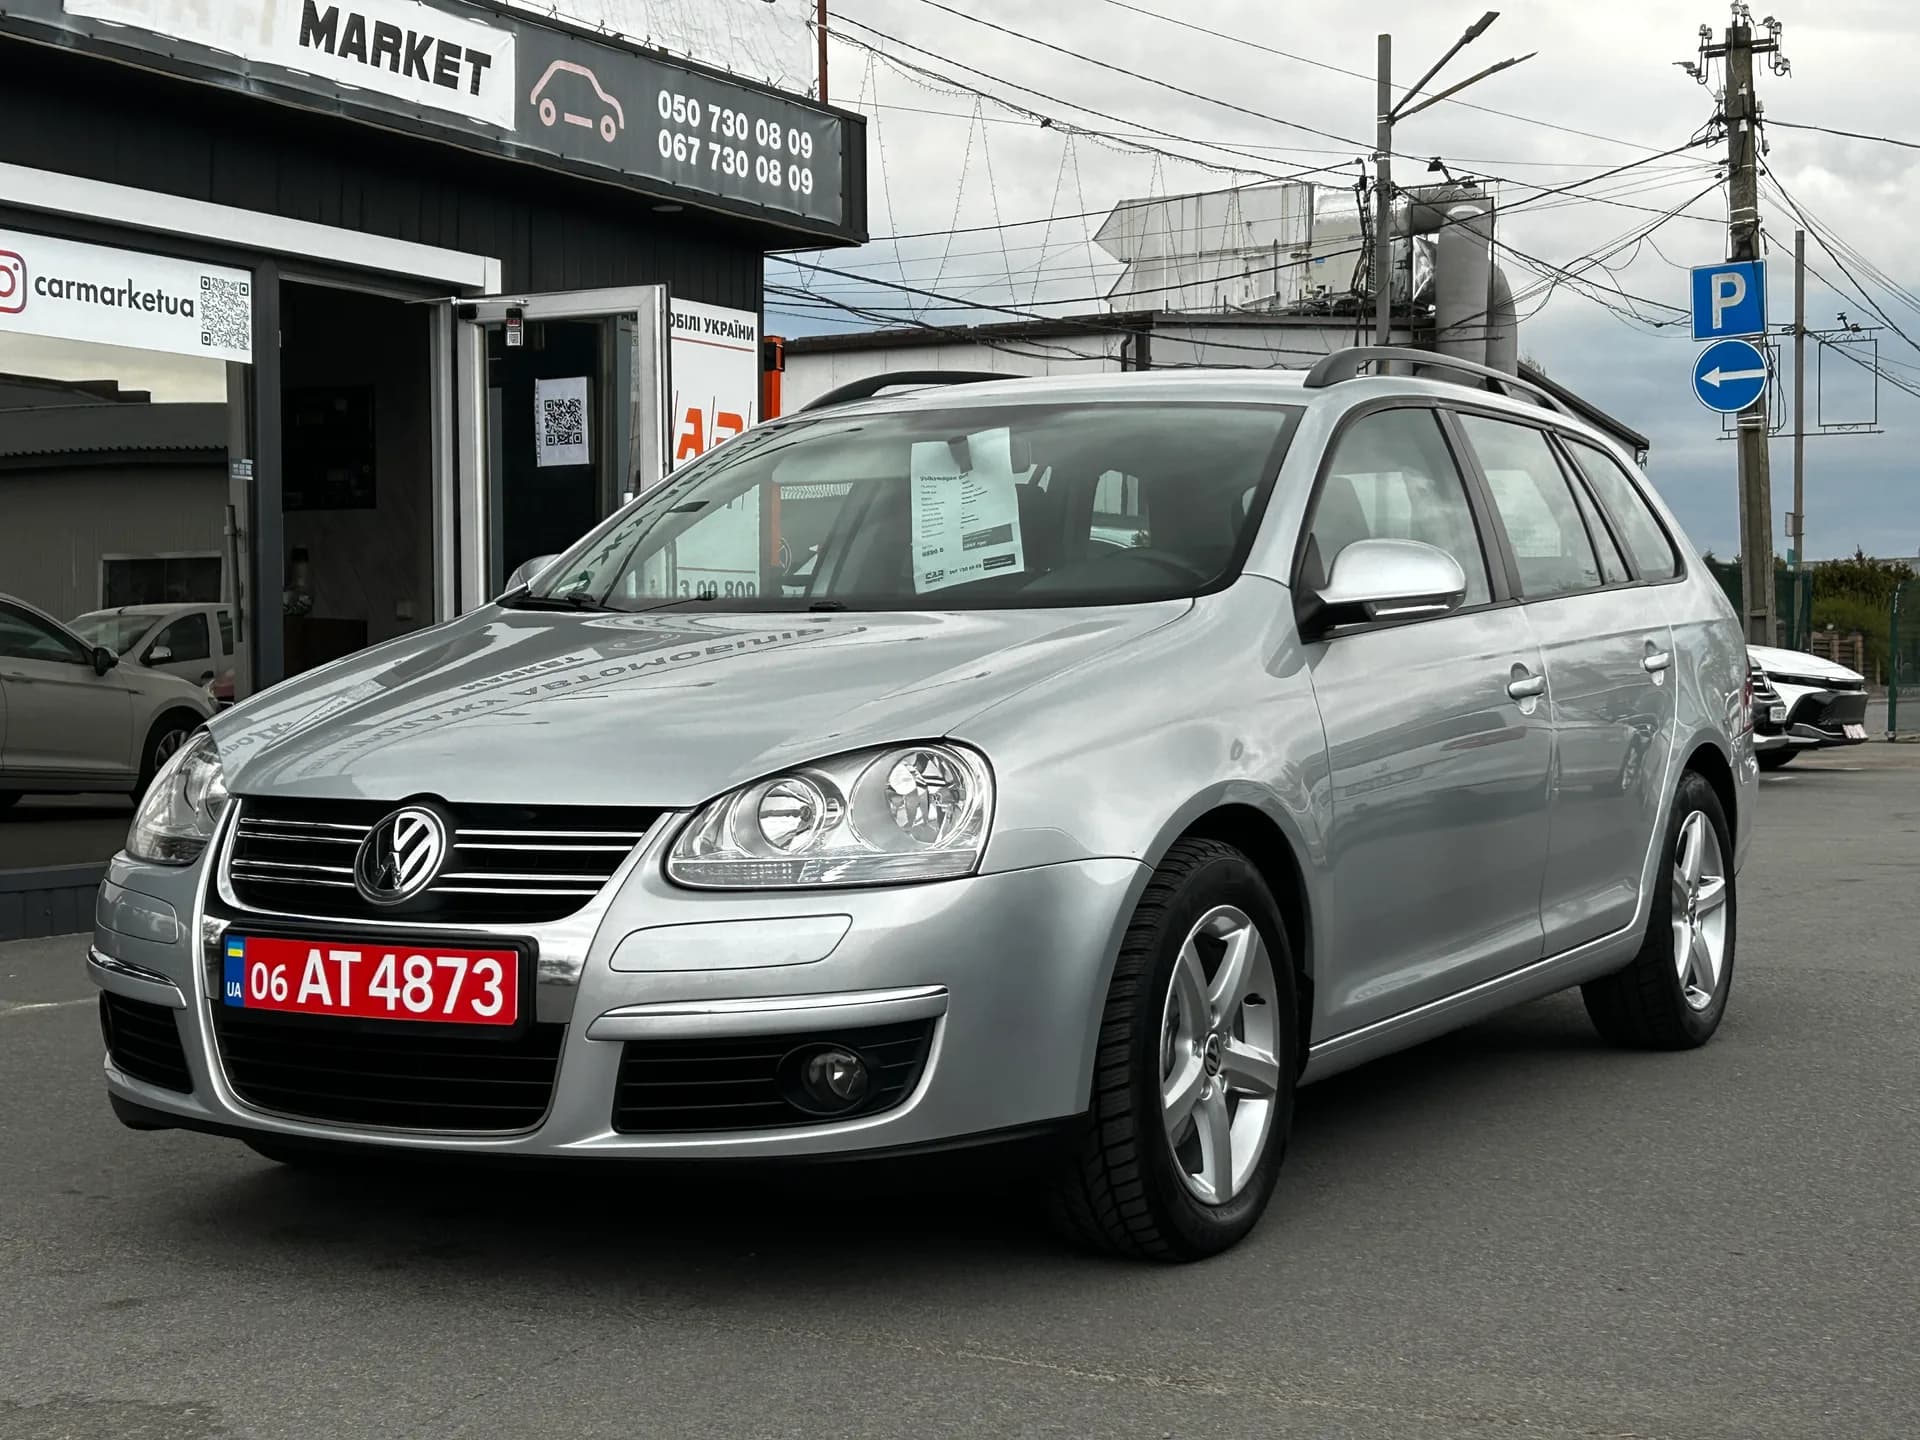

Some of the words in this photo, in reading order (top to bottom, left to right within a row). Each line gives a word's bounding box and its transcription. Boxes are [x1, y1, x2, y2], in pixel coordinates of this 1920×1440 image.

[299, 0, 492, 96] MARKET
[658, 90, 701, 128] 050
[708, 104, 749, 141] 730
[755, 118, 782, 150] 08
[788, 128, 813, 159] 09
[658, 129, 701, 166] 067
[708, 142, 749, 178] 730
[755, 155, 782, 187] 08
[788, 165, 813, 195] 09
[34, 275, 195, 318] carmarketua
[1711, 272, 1747, 330] P
[703, 317, 754, 342] УКРАЇНИ
[226, 981, 242, 999] UA
[251, 961, 288, 1002] 06
[297, 948, 362, 1007] AT
[368, 954, 503, 1017] 4873
